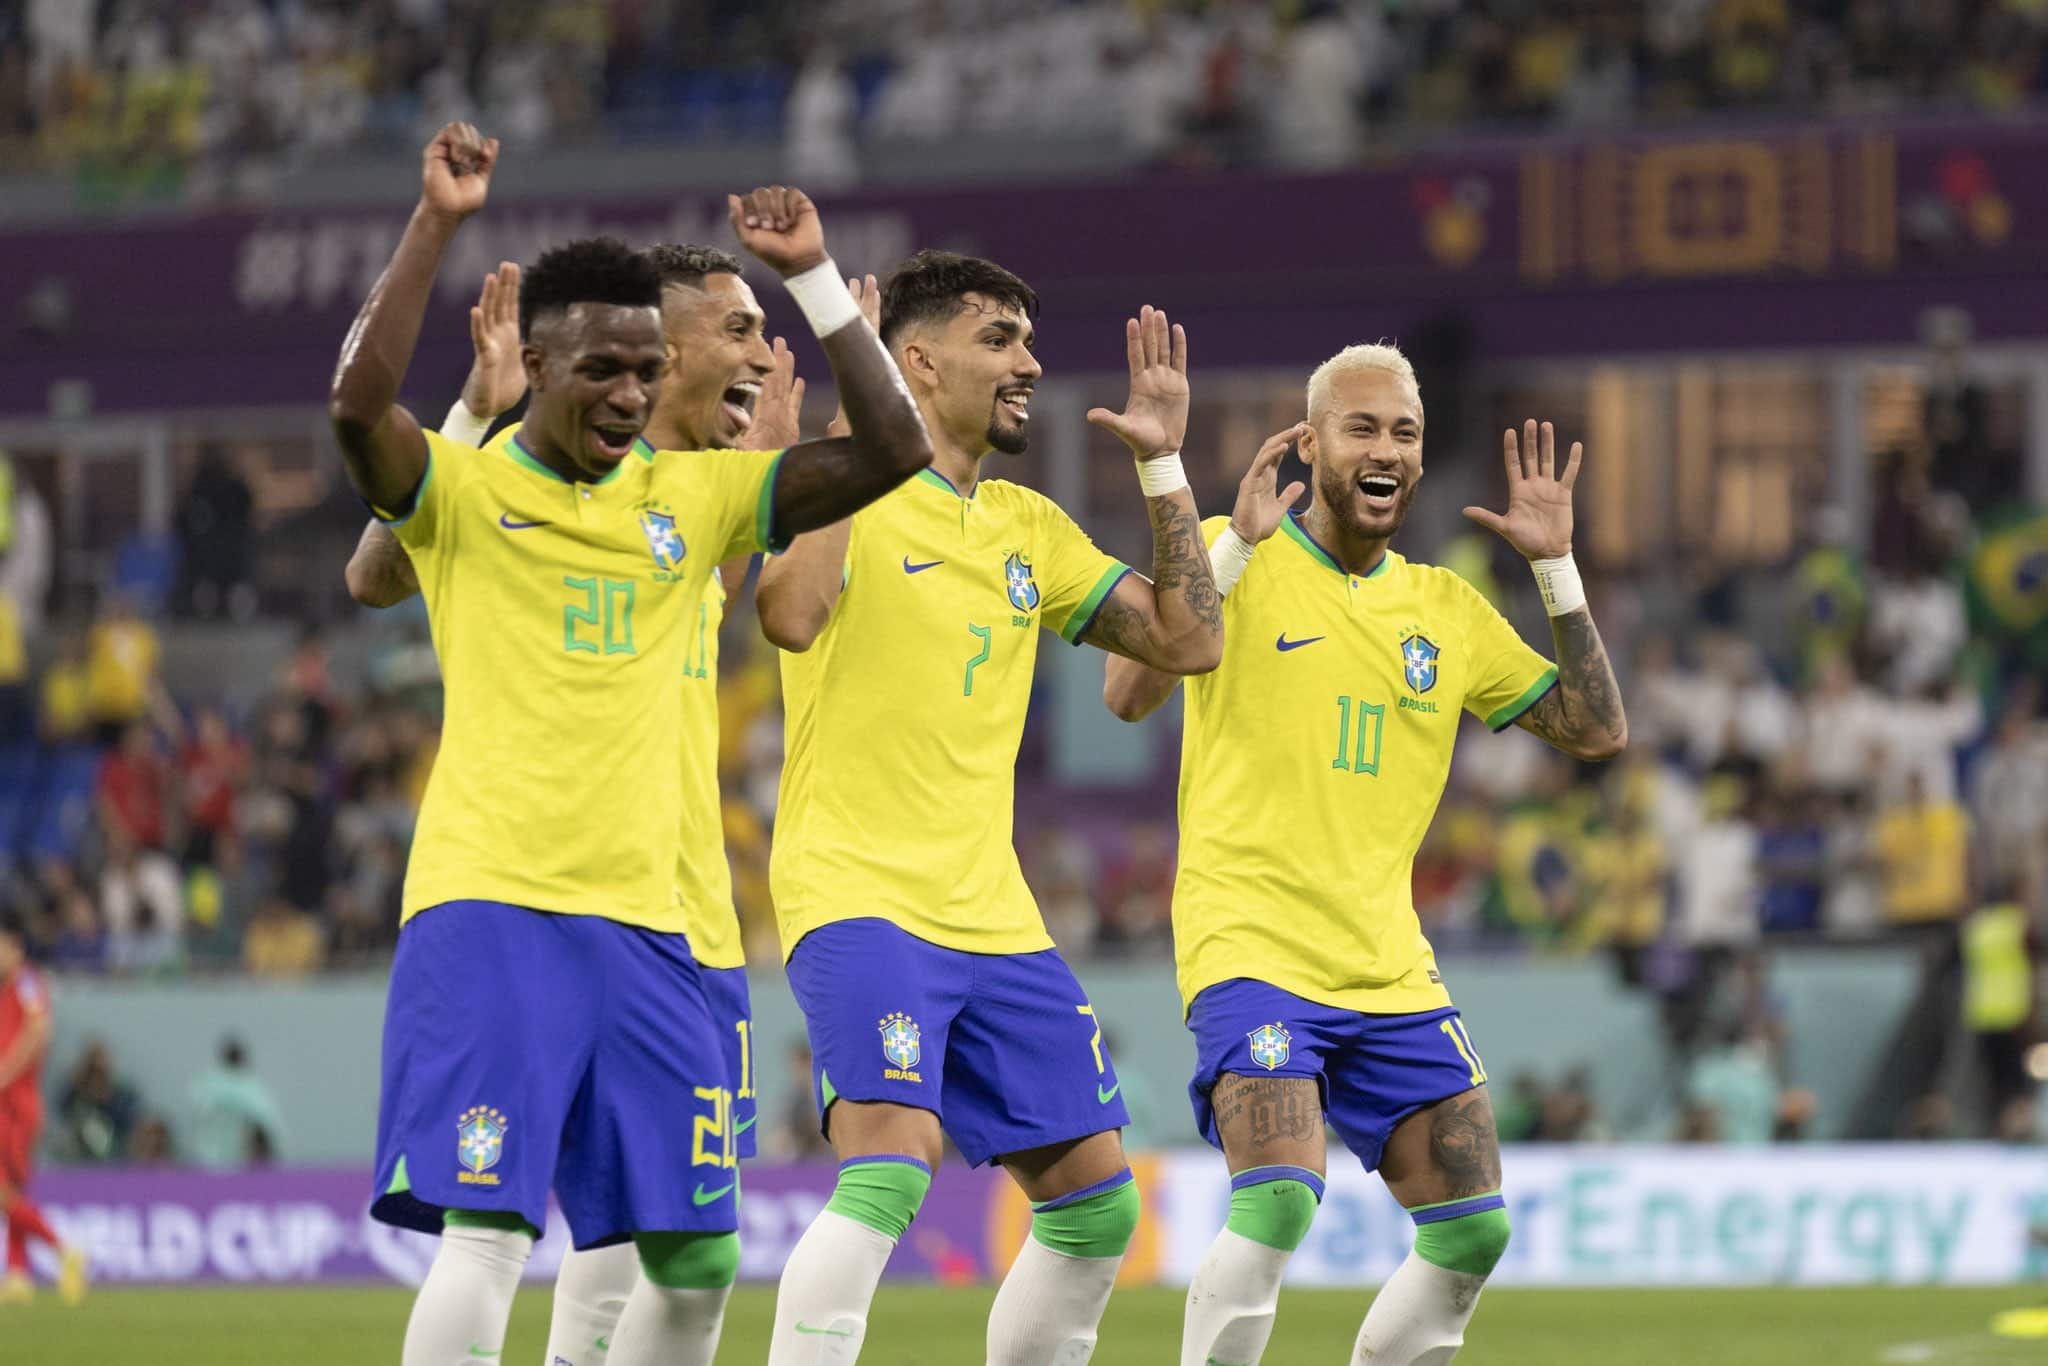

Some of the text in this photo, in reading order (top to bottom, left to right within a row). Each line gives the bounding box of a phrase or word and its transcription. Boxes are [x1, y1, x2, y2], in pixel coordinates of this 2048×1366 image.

[563, 576, 637, 656] 20
[682, 602, 707, 680] 1
[1012, 615, 1033, 628] BRA
[963, 621, 991, 697] 7
[1332, 695, 1386, 778] 10
[1398, 696, 1440, 713] BRASIL
[884, 1068, 923, 1083] BRASIL
[1075, 1003, 1105, 1075] 7
[207, 1202, 340, 1281] CUP
